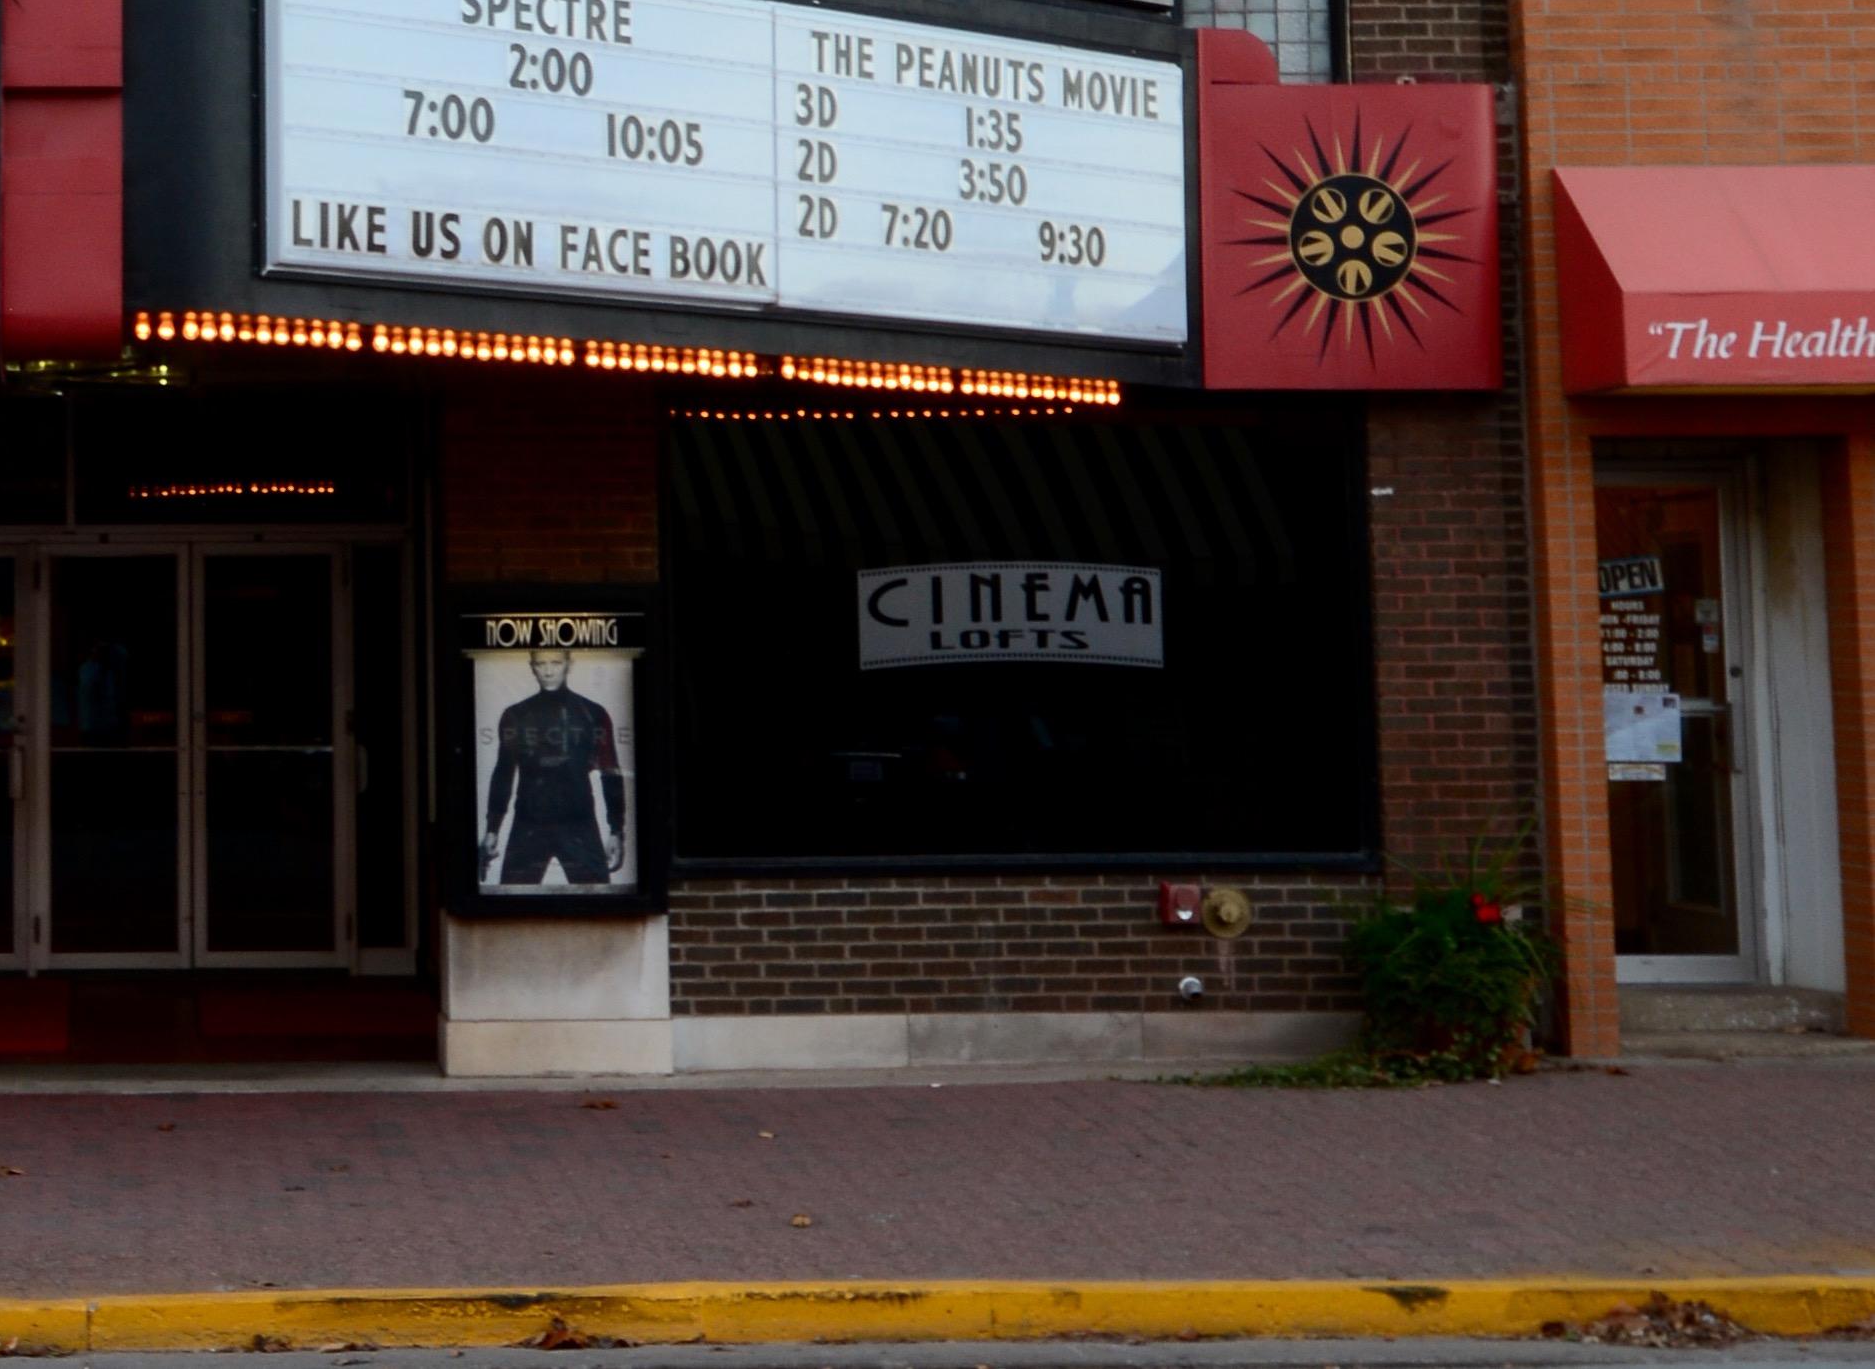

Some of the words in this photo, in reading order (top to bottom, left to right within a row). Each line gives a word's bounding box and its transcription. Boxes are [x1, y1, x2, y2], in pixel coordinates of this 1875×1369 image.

[509, 43, 594, 96] 2:00
[811, 30, 874, 80] THE
[896, 43, 1045, 103] PEANUTS
[1063, 67, 1159, 120] MOVIE
[403, 90, 495, 143] 7:00
[606, 112, 704, 166] 10:05
[795, 83, 838, 129] 3D
[965, 107, 1023, 154] 1:35
[797, 139, 838, 183] 2D
[960, 159, 1028, 206] 3:50
[292, 199, 388, 254] LIKE
[411, 210, 461, 260] US
[483, 216, 534, 267] ON
[560, 225, 652, 277] FACE
[669, 235, 767, 287] BOOK
[798, 194, 839, 239] 2D
[881, 204, 953, 251] 7:20
[1039, 221, 1106, 268] 9:30
[867, 573, 1153, 627] CINEMA
[1598, 560, 1658, 592] OPEN
[486, 619, 533, 647] NOW
[538, 618, 618, 647] SHOWING
[930, 629, 1090, 650] LOFTS
[478, 727, 633, 746] SPECTRE
